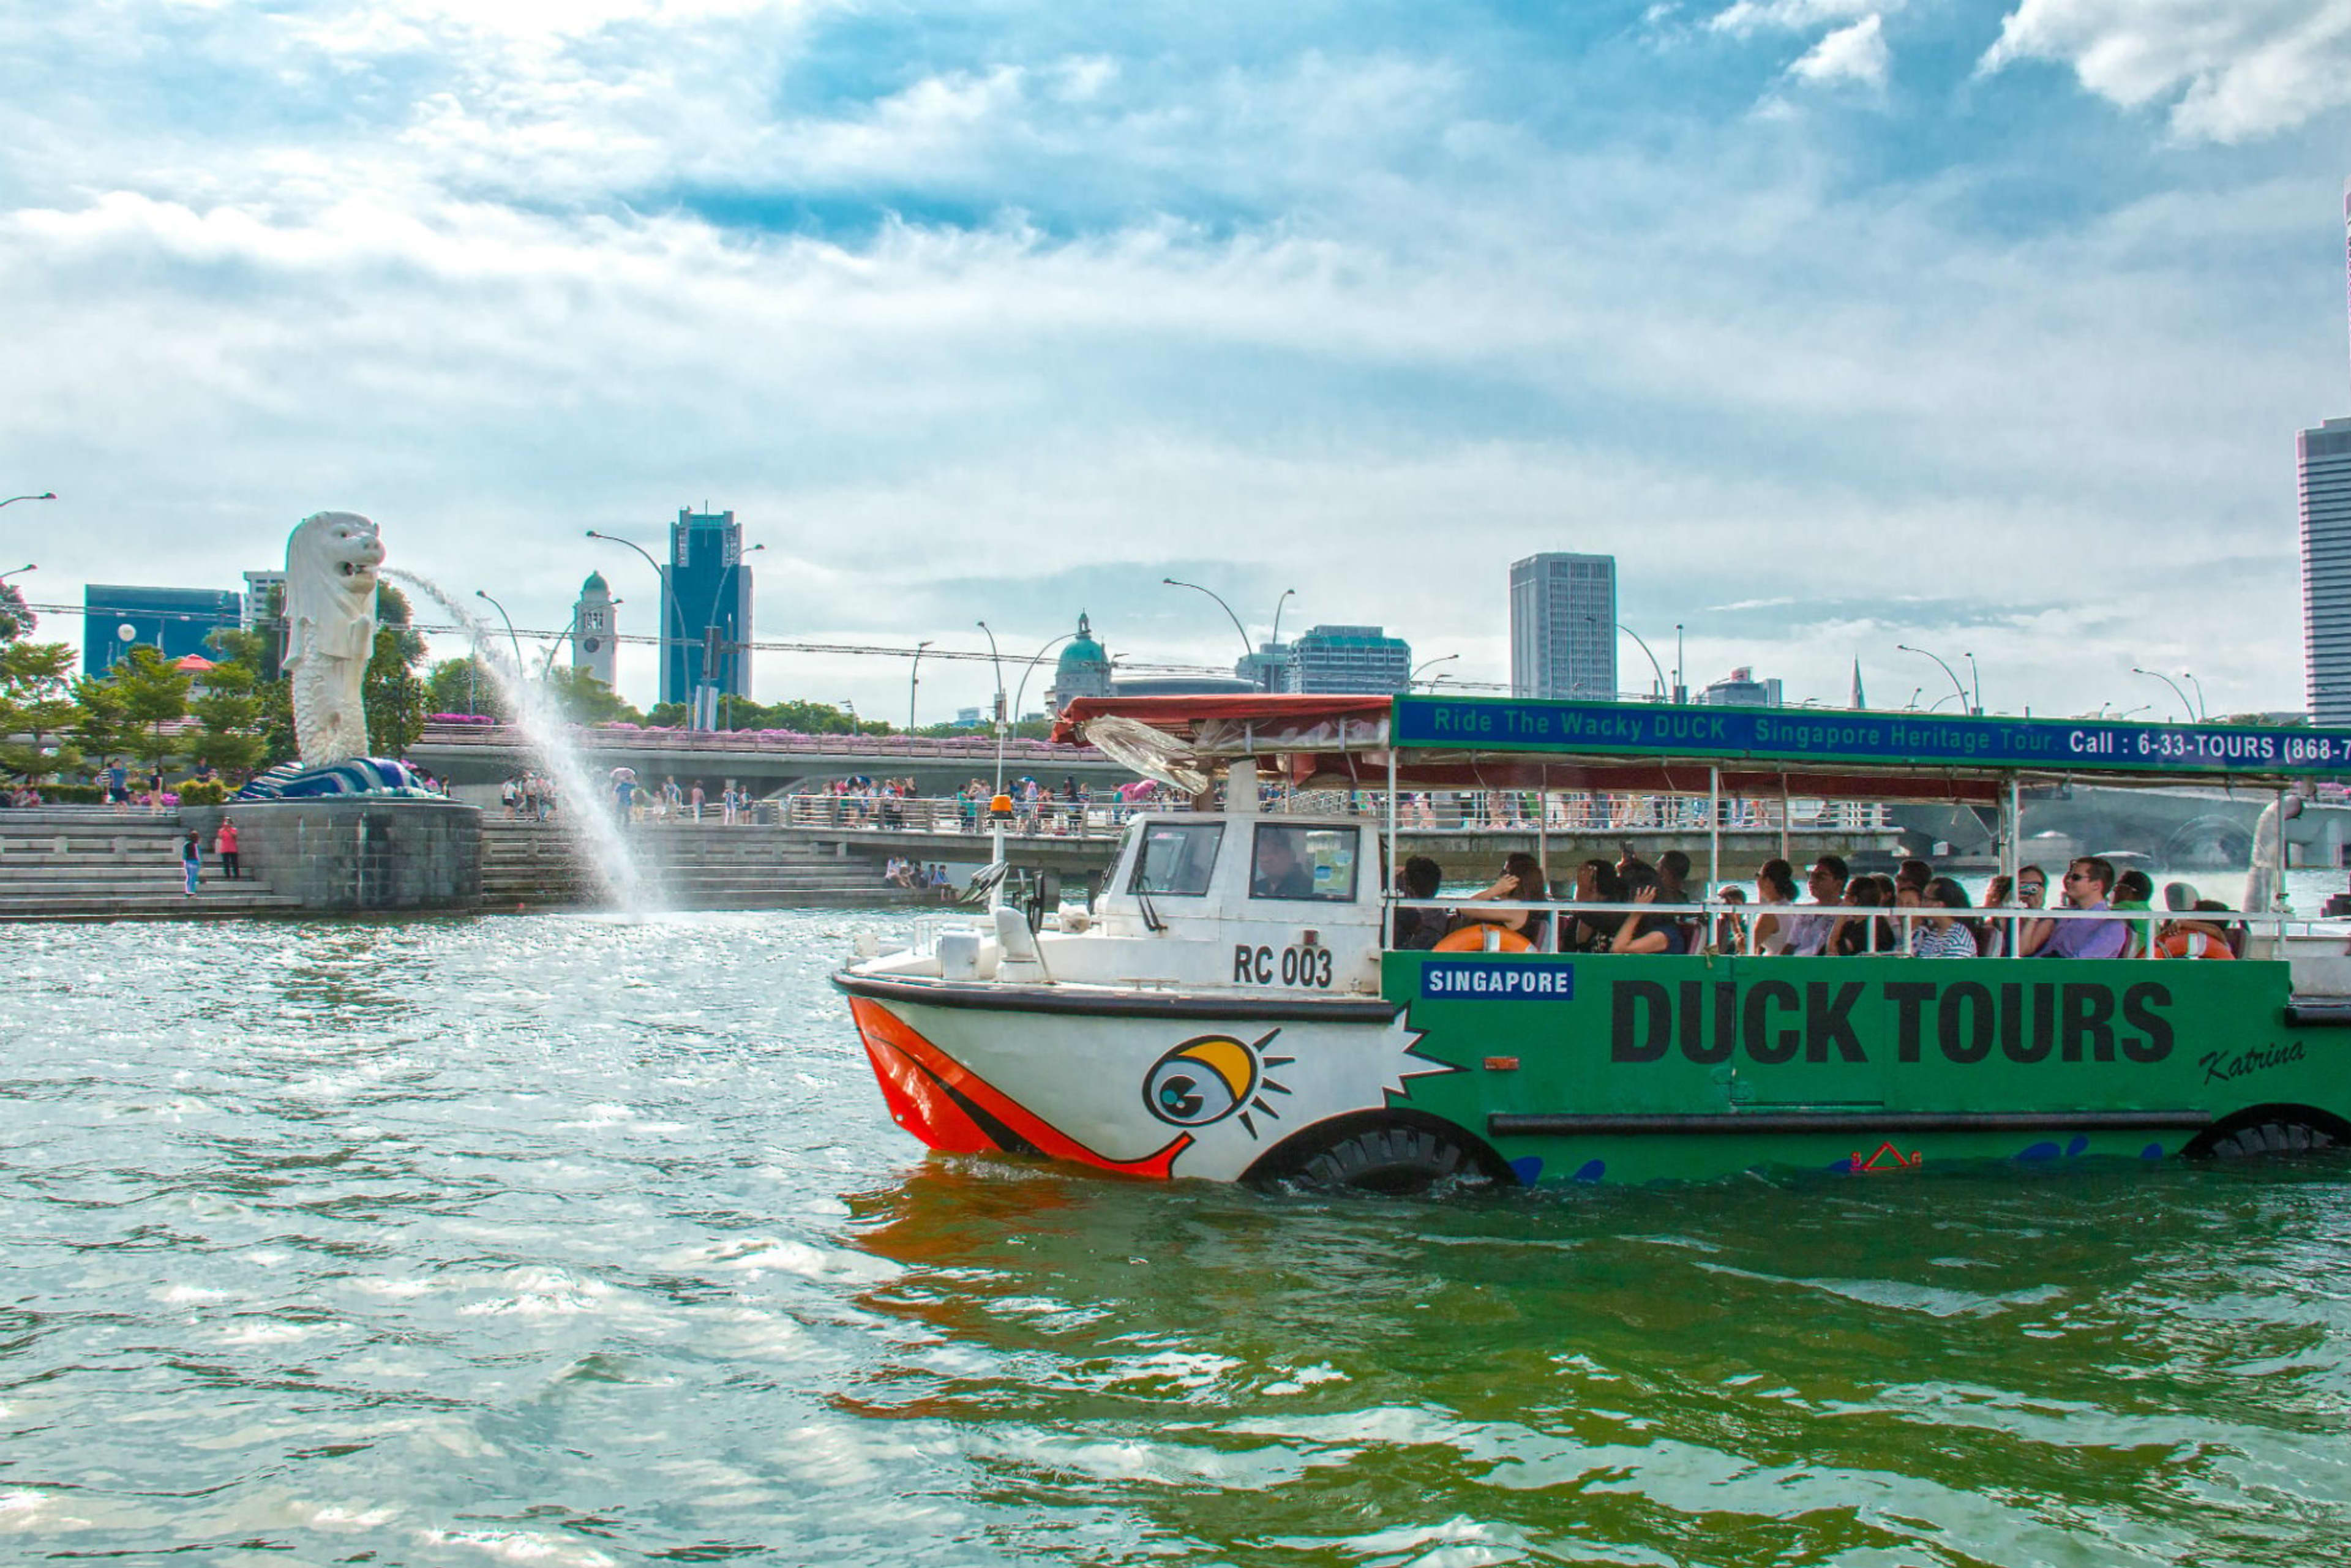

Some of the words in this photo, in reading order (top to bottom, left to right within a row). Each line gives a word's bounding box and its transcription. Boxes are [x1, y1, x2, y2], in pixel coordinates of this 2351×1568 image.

[1434, 708, 1492, 732] Ride
[1504, 710, 1550, 733] The
[1561, 712, 1643, 742] Wacky
[1654, 715, 1725, 740] DUCK
[1755, 718, 1880, 749] Singapore
[1891, 725, 1990, 753] Heritage
[2069, 730, 2113, 753] Call
[2137, 733, 2274, 759] 6-33-TOURS
[1234, 943, 1273, 983] RC
[1281, 947, 1333, 988] 003
[1428, 970, 1569, 993] SINGAPORE
[1611, 978, 1869, 1064] DUCK
[1883, 981, 2175, 1065] TOURS
[2197, 1040, 2307, 1086] Katrina
